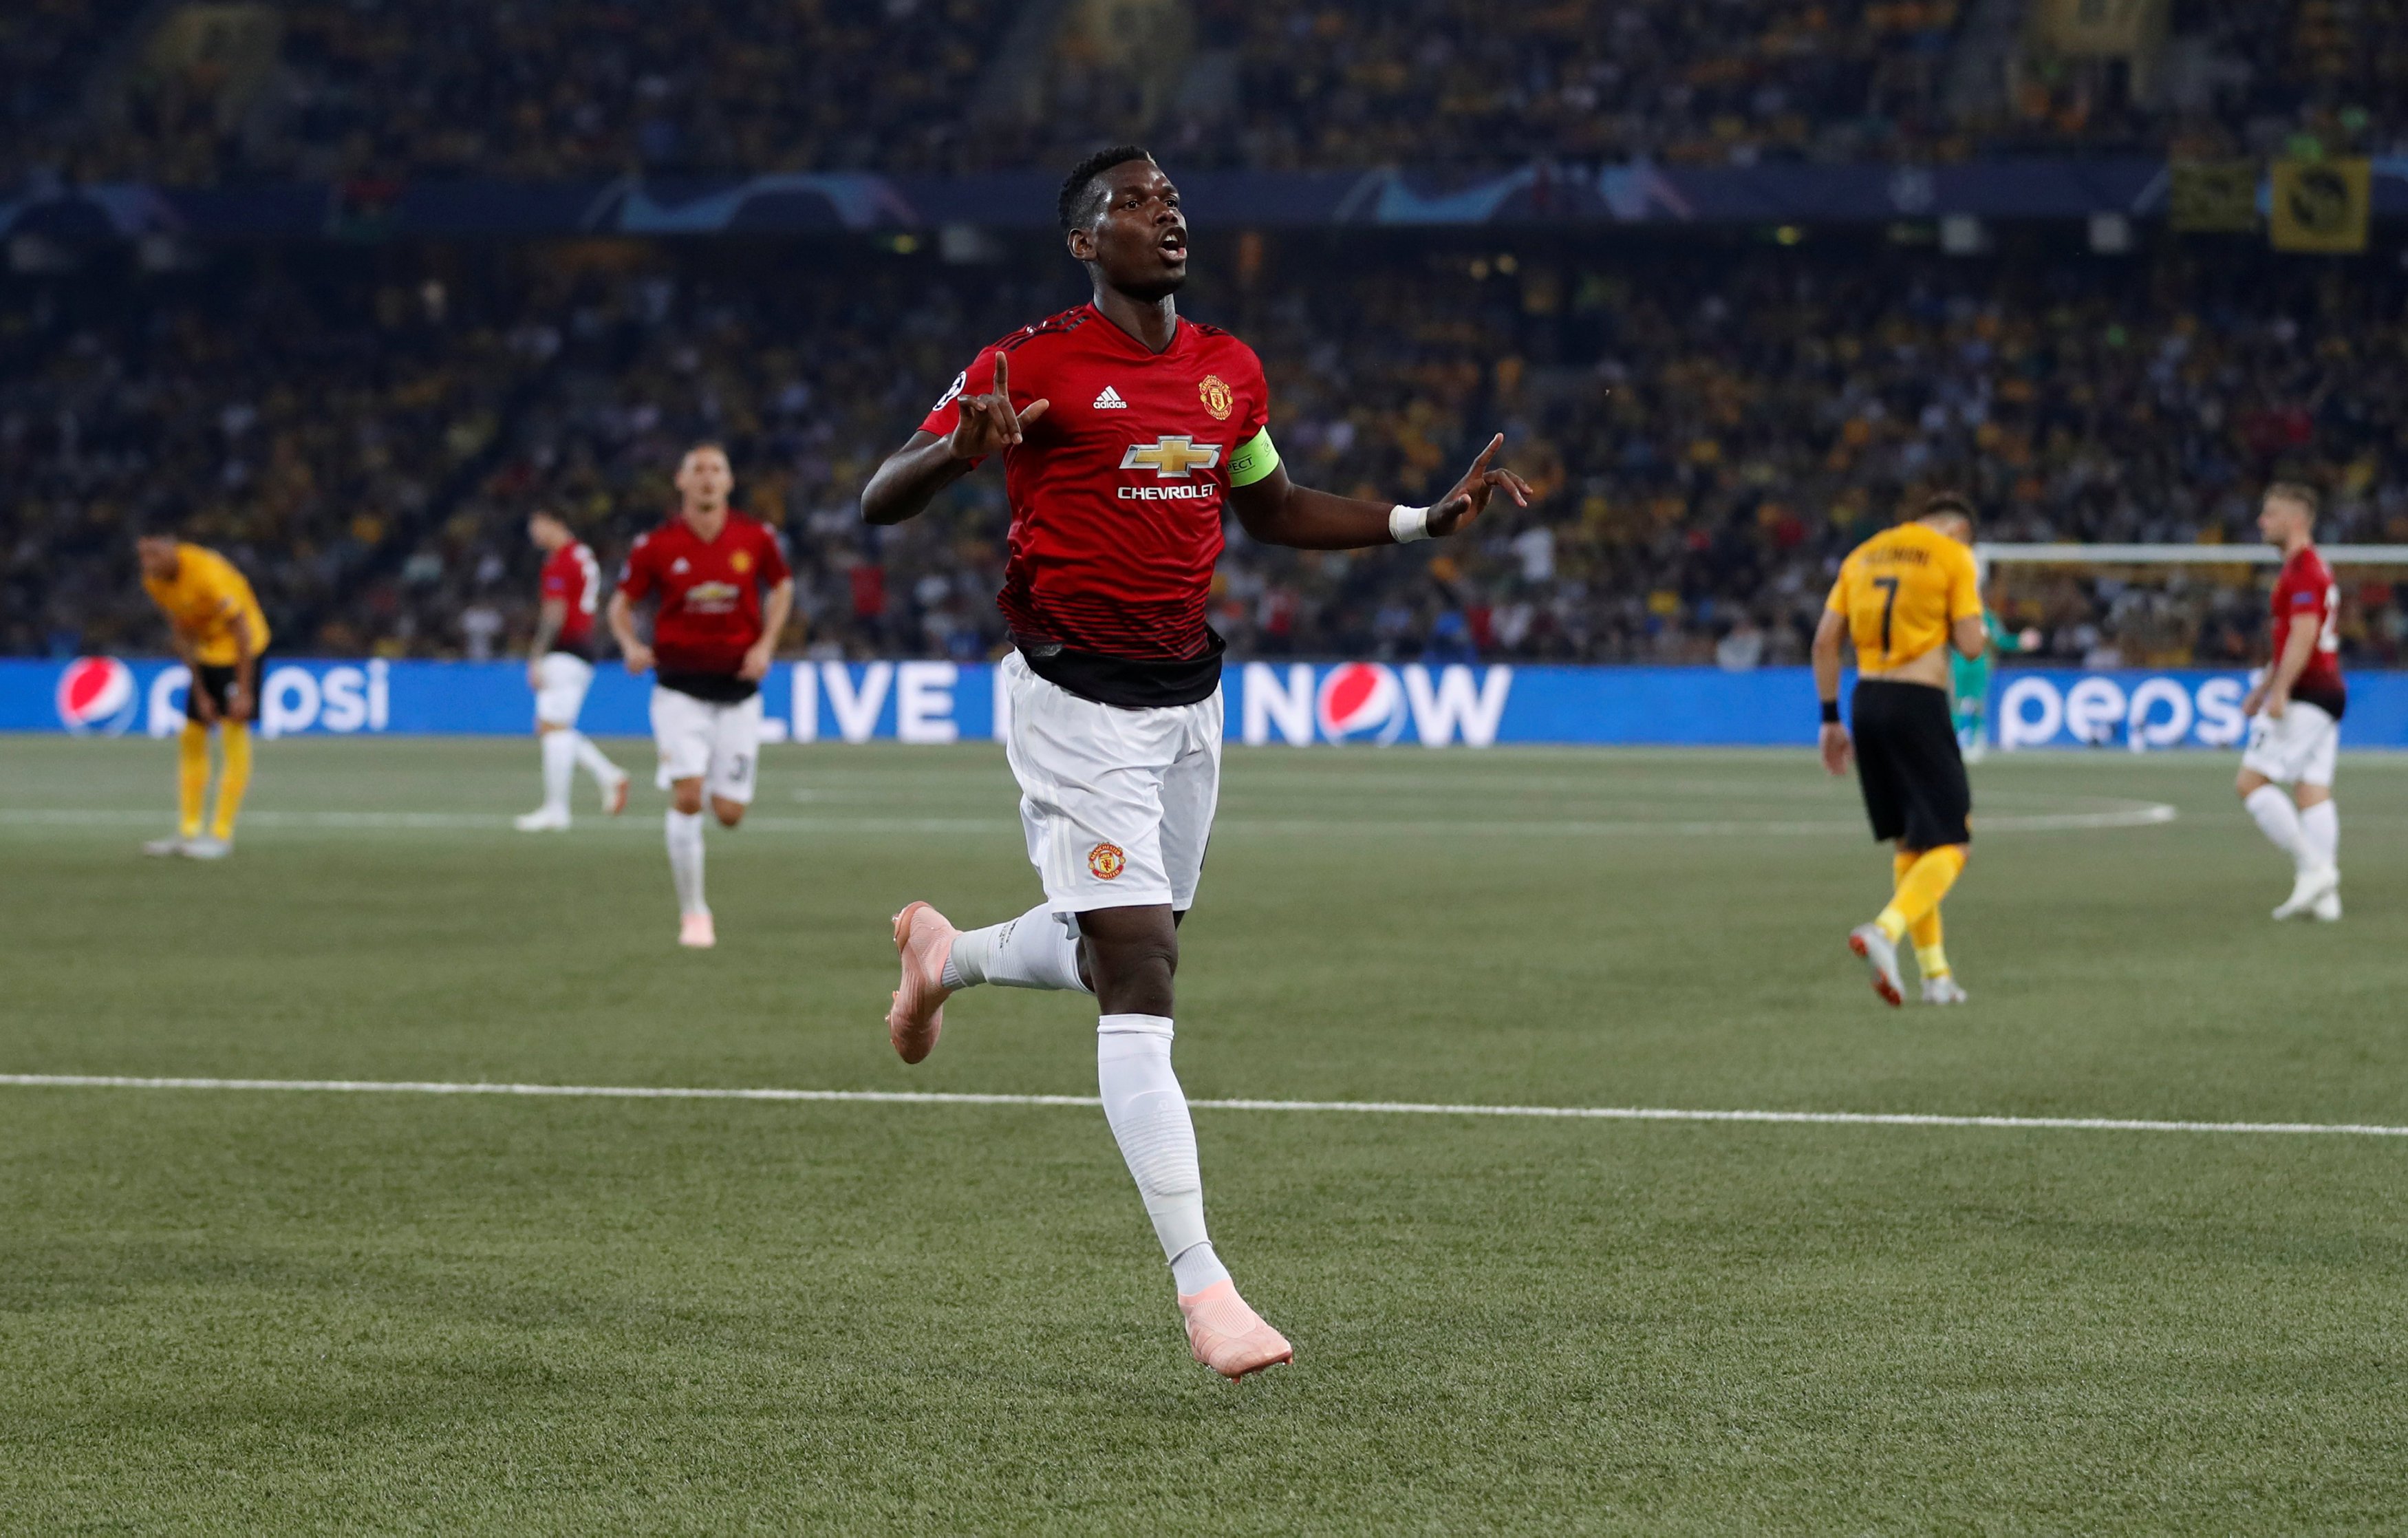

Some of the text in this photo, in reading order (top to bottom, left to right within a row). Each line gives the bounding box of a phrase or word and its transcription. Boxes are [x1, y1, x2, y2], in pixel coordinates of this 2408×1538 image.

[1093, 400, 1128, 409] adidas
[1117, 483, 1217, 500] CHEVROLET
[1873, 577, 1899, 652] 7
[147, 657, 390, 739] ppsi
[758, 660, 960, 743] IVE
[1098, 869, 1119, 879] UNITED
